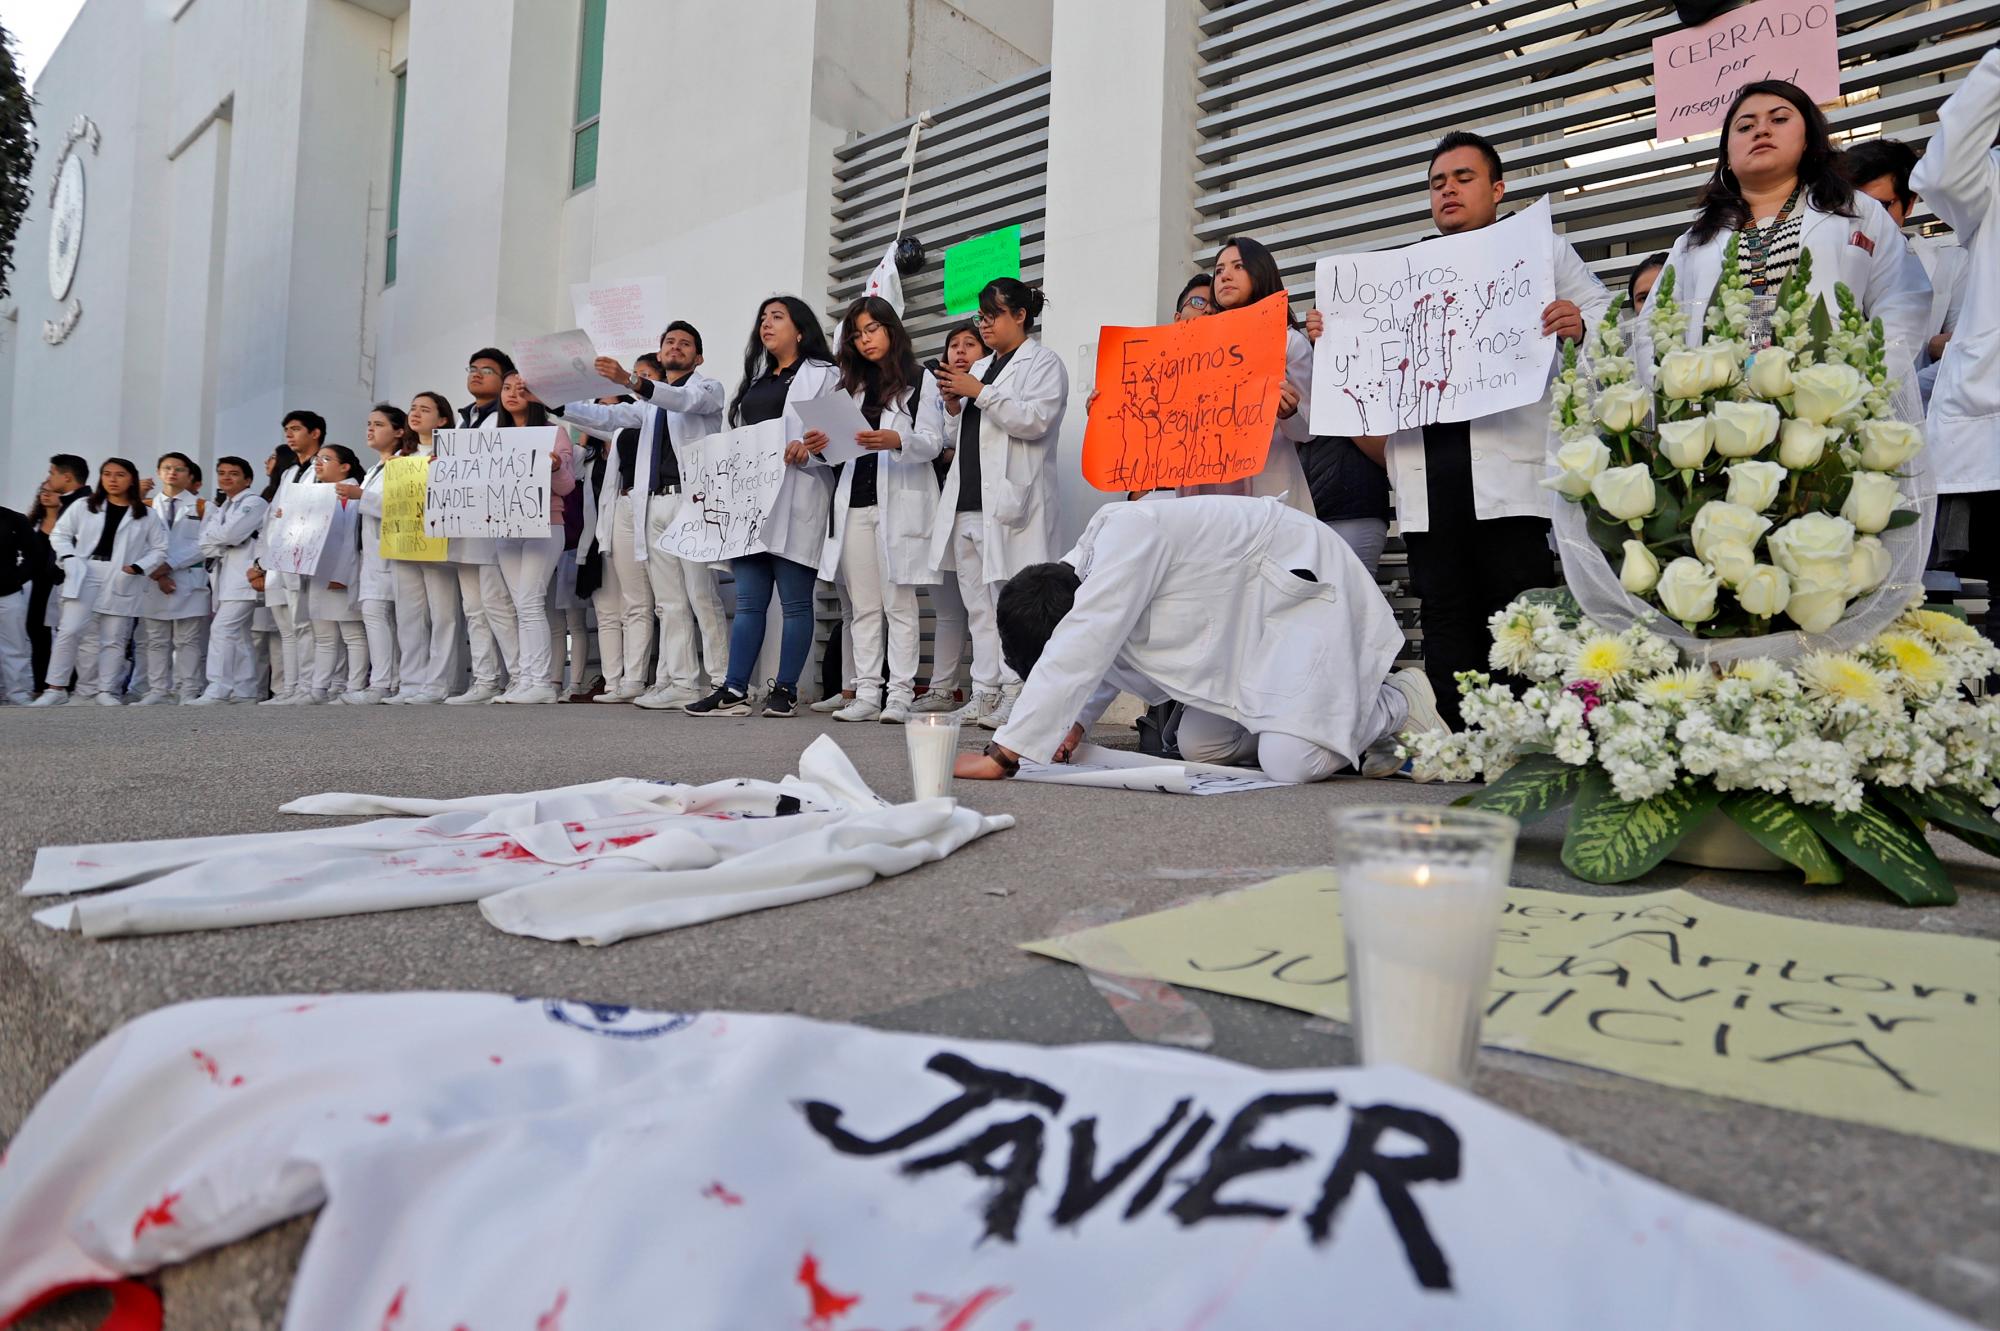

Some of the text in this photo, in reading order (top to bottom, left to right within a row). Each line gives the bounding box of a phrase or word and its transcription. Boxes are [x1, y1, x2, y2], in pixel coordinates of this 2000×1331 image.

[1668, 4, 1828, 69] CERRADO
[1715, 54, 1757, 87] por
[1332, 257, 1459, 304] Nosotros
[1121, 338, 1245, 404] Exigimos
[1444, 362, 1518, 410] quitan
[469, 432, 503, 454] UNA
[434, 458, 481, 483] BATA
[1187, 948, 1940, 1099] JUTICIA
[797, 1051, 1463, 1293] JAVIER
